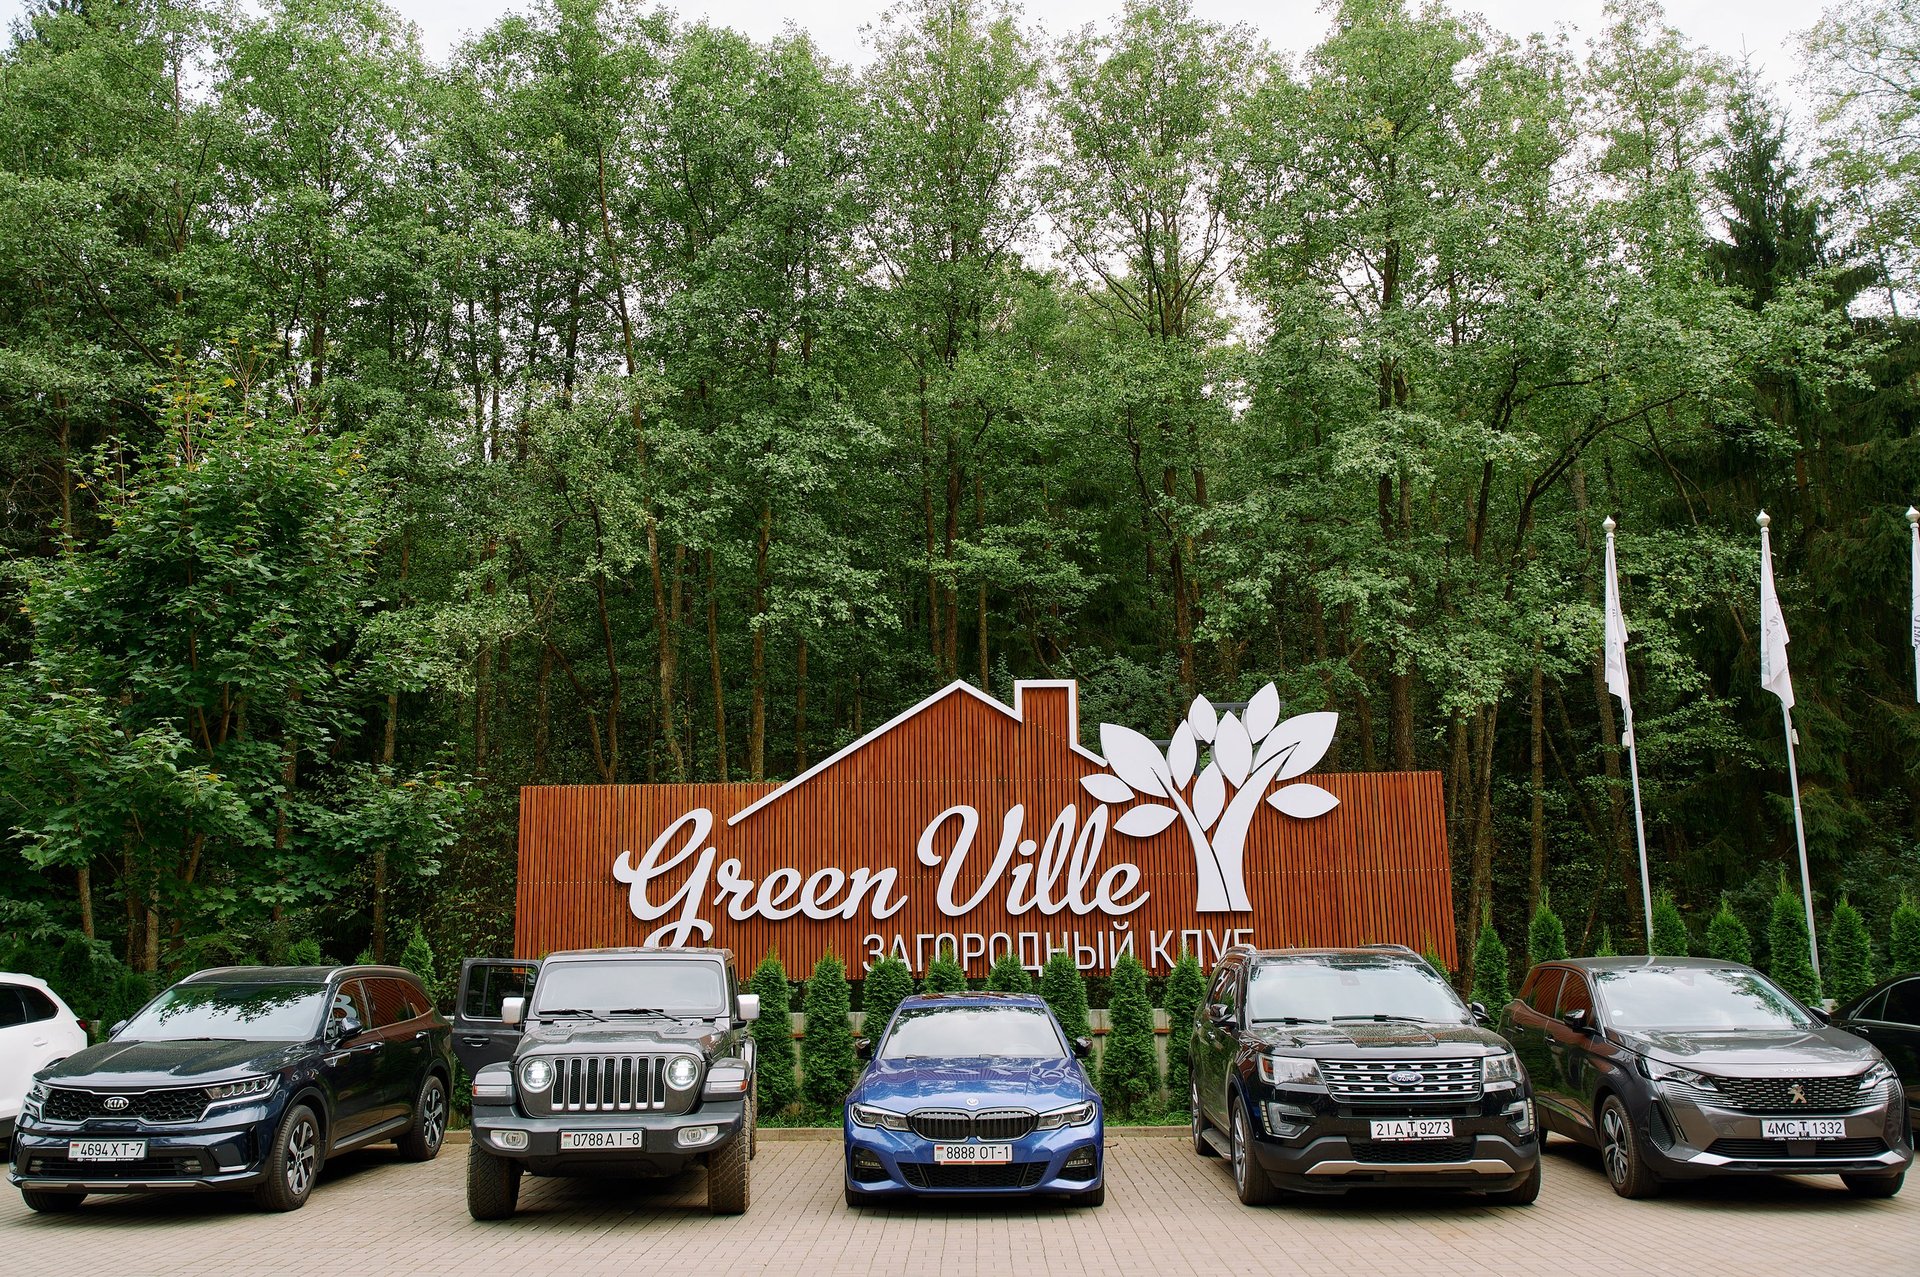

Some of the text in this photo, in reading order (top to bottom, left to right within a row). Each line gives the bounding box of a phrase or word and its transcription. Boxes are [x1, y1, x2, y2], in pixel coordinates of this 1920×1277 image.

[613, 804, 1150, 947] Green Ville
[862, 921, 1133, 977] ЗАГОРОДНЫЙ
[1396, 1072, 1417, 1082] Ford
[107, 1099, 124, 1108] KIA
[1420, 1121, 1450, 1134] 9273
[1813, 1122, 1842, 1134] 1332
[573, 1133, 603, 1146] 0788
[81, 1143, 108, 1156] 4694
[947, 1146, 975, 1159] 8888
